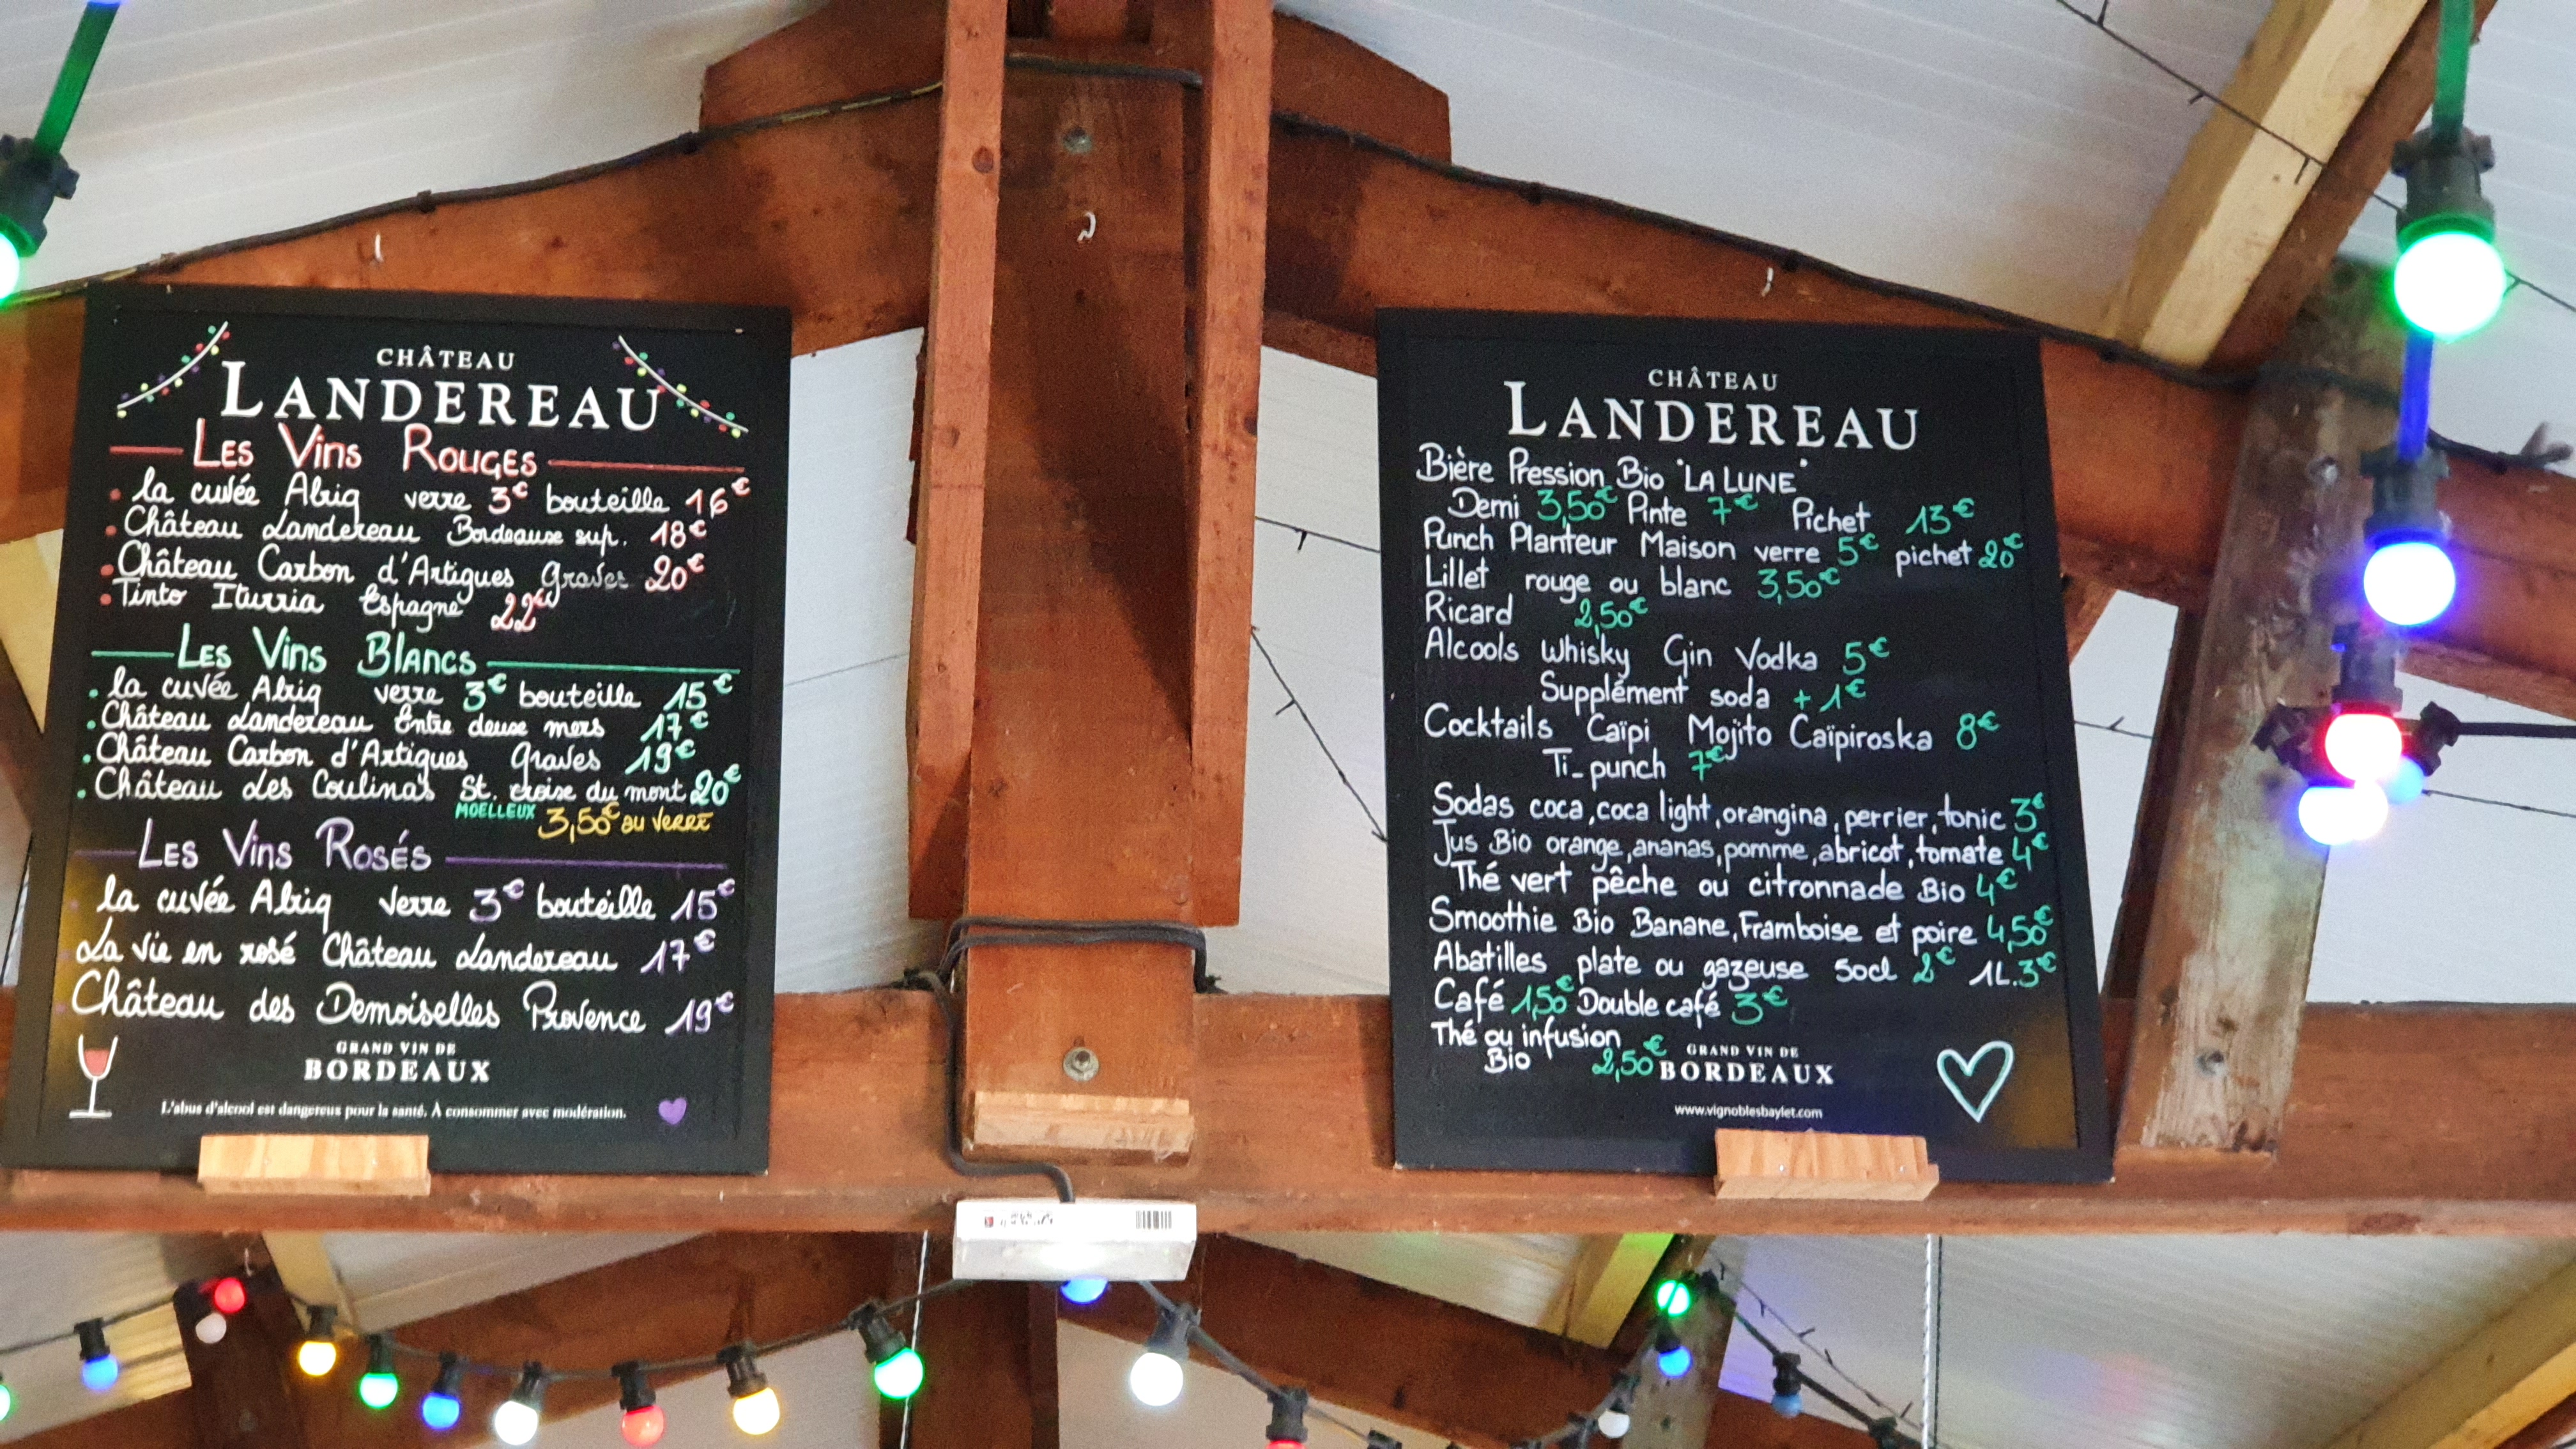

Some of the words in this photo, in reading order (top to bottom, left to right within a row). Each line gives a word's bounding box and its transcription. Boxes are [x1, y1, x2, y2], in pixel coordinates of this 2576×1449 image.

[377, 345, 514, 369] CHÂTEAU
[221, 361, 659, 431] LANDEREAU
[1648, 365, 1777, 391] CHÂTEAU
[1504, 381, 1917, 449] LANDEREAU
[1416, 441, 1494, 482] Bière
[1509, 447, 1605, 486] Pression
[1616, 456, 1664, 490] Bio
[191, 473, 260, 505] cuvée
[404, 489, 471, 511] verre
[547, 483, 670, 514] bouteille
[1448, 486, 1519, 520] Demi
[1629, 490, 1687, 527] Pinte
[1793, 496, 1871, 533] Pichet
[124, 505, 243, 539] Château
[262, 509, 420, 542] Landereau
[118, 540, 238, 579] Château
[258, 544, 354, 583] Carbon
[1423, 516, 1494, 551] Punch
[1510, 521, 1618, 555] Planteur
[1641, 530, 1735, 560] Maison
[1754, 546, 1820, 563] verre
[1896, 540, 1972, 578] pichet
[112, 577, 187, 607] Tinto
[1426, 555, 1489, 589] Lillet
[1525, 573, 1591, 604] rouge
[1609, 577, 1638, 594] ou
[1661, 565, 1732, 599] blanc
[1426, 590, 1513, 625] Ricard
[1425, 626, 1519, 662] Alcools
[1542, 633, 1630, 678] Whisky
[1664, 633, 1712, 678] Gin
[1735, 638, 1818, 671] Vodka
[162, 672, 238, 700] cuvée
[374, 679, 443, 703] verre
[520, 680, 641, 709] bouteille
[1540, 670, 1689, 716] Supplément
[1710, 675, 1769, 708] soda
[102, 700, 211, 732] Château
[228, 702, 374, 733] Landereau
[1424, 702, 1553, 739] Cocktails
[96, 732, 211, 766] Château
[228, 735, 313, 767] Carbon
[95, 765, 222, 800] Château
[586, 781, 619, 804] du
[624, 781, 687, 803] mont
[455, 803, 537, 819] MOELLEUX
[1432, 781, 1514, 818] Sodas
[1597, 801, 1649, 821] coca
[1938, 792, 2005, 830] tonic
[1432, 818, 1478, 866] Jus
[1489, 828, 1531, 854] Bio
[1916, 834, 2004, 865] tomate
[158, 874, 236, 914] cuvée
[379, 885, 450, 916] verre
[537, 882, 656, 919] bouteille
[1451, 861, 1501, 892] Thé
[1511, 861, 1572, 894] vert
[1592, 864, 1677, 905] pêche
[1699, 878, 1729, 896] ou
[1749, 862, 1905, 901] citronnade
[1917, 878, 1965, 903] Bio
[1429, 896, 1557, 933] Smoothie
[1573, 907, 1614, 935] Bio
[1740, 910, 1862, 942] Framboise
[1876, 912, 1902, 944] et
[1912, 921, 1977, 956] poire
[181, 939, 222, 965] en
[240, 931, 297, 965] rosé
[323, 931, 437, 969] Château
[456, 932, 618, 971] Landereau
[1434, 940, 1547, 974] Abatilles
[1577, 946, 1641, 984] plate
[1656, 959, 1683, 976] ou
[1703, 958, 1809, 992] gazeuse
[72, 967, 224, 1020] Château
[249, 987, 295, 1023] des
[316, 981, 501, 1028] Demoiselles
[523, 979, 646, 1033] Provence
[1434, 976, 1504, 1023] Café
[1577, 986, 1660, 1016] Double
[1666, 987, 1721, 1029] café
[336, 1040, 393, 1055] GRAND
[401, 1042, 429, 1055] VIN
[436, 1043, 456, 1056] DE
[1431, 1018, 1477, 1046] Thé
[1484, 1031, 1512, 1049] ou
[1522, 1016, 1621, 1059] infusion
[1687, 1043, 1739, 1056] GRAND
[1746, 1045, 1772, 1057] VIN
[1780, 1046, 1798, 1057] DE
[304, 1057, 491, 1083] BORDEAUX
[1485, 1048, 1531, 1073] Bio
[1660, 1061, 1834, 1084] BORDEAUX
[161, 1100, 201, 1116] L'abus
[206, 1100, 254, 1116] d'alcool
[257, 1103, 275, 1116] est
[279, 1101, 341, 1118] dangereux
[346, 1105, 374, 1119] pour
[379, 1101, 388, 1117] la
[446, 1107, 519, 1119] consommer
[522, 1108, 549, 1119] avec
[1675, 1104, 1823, 1119] www.vignoblesbaylet.com
